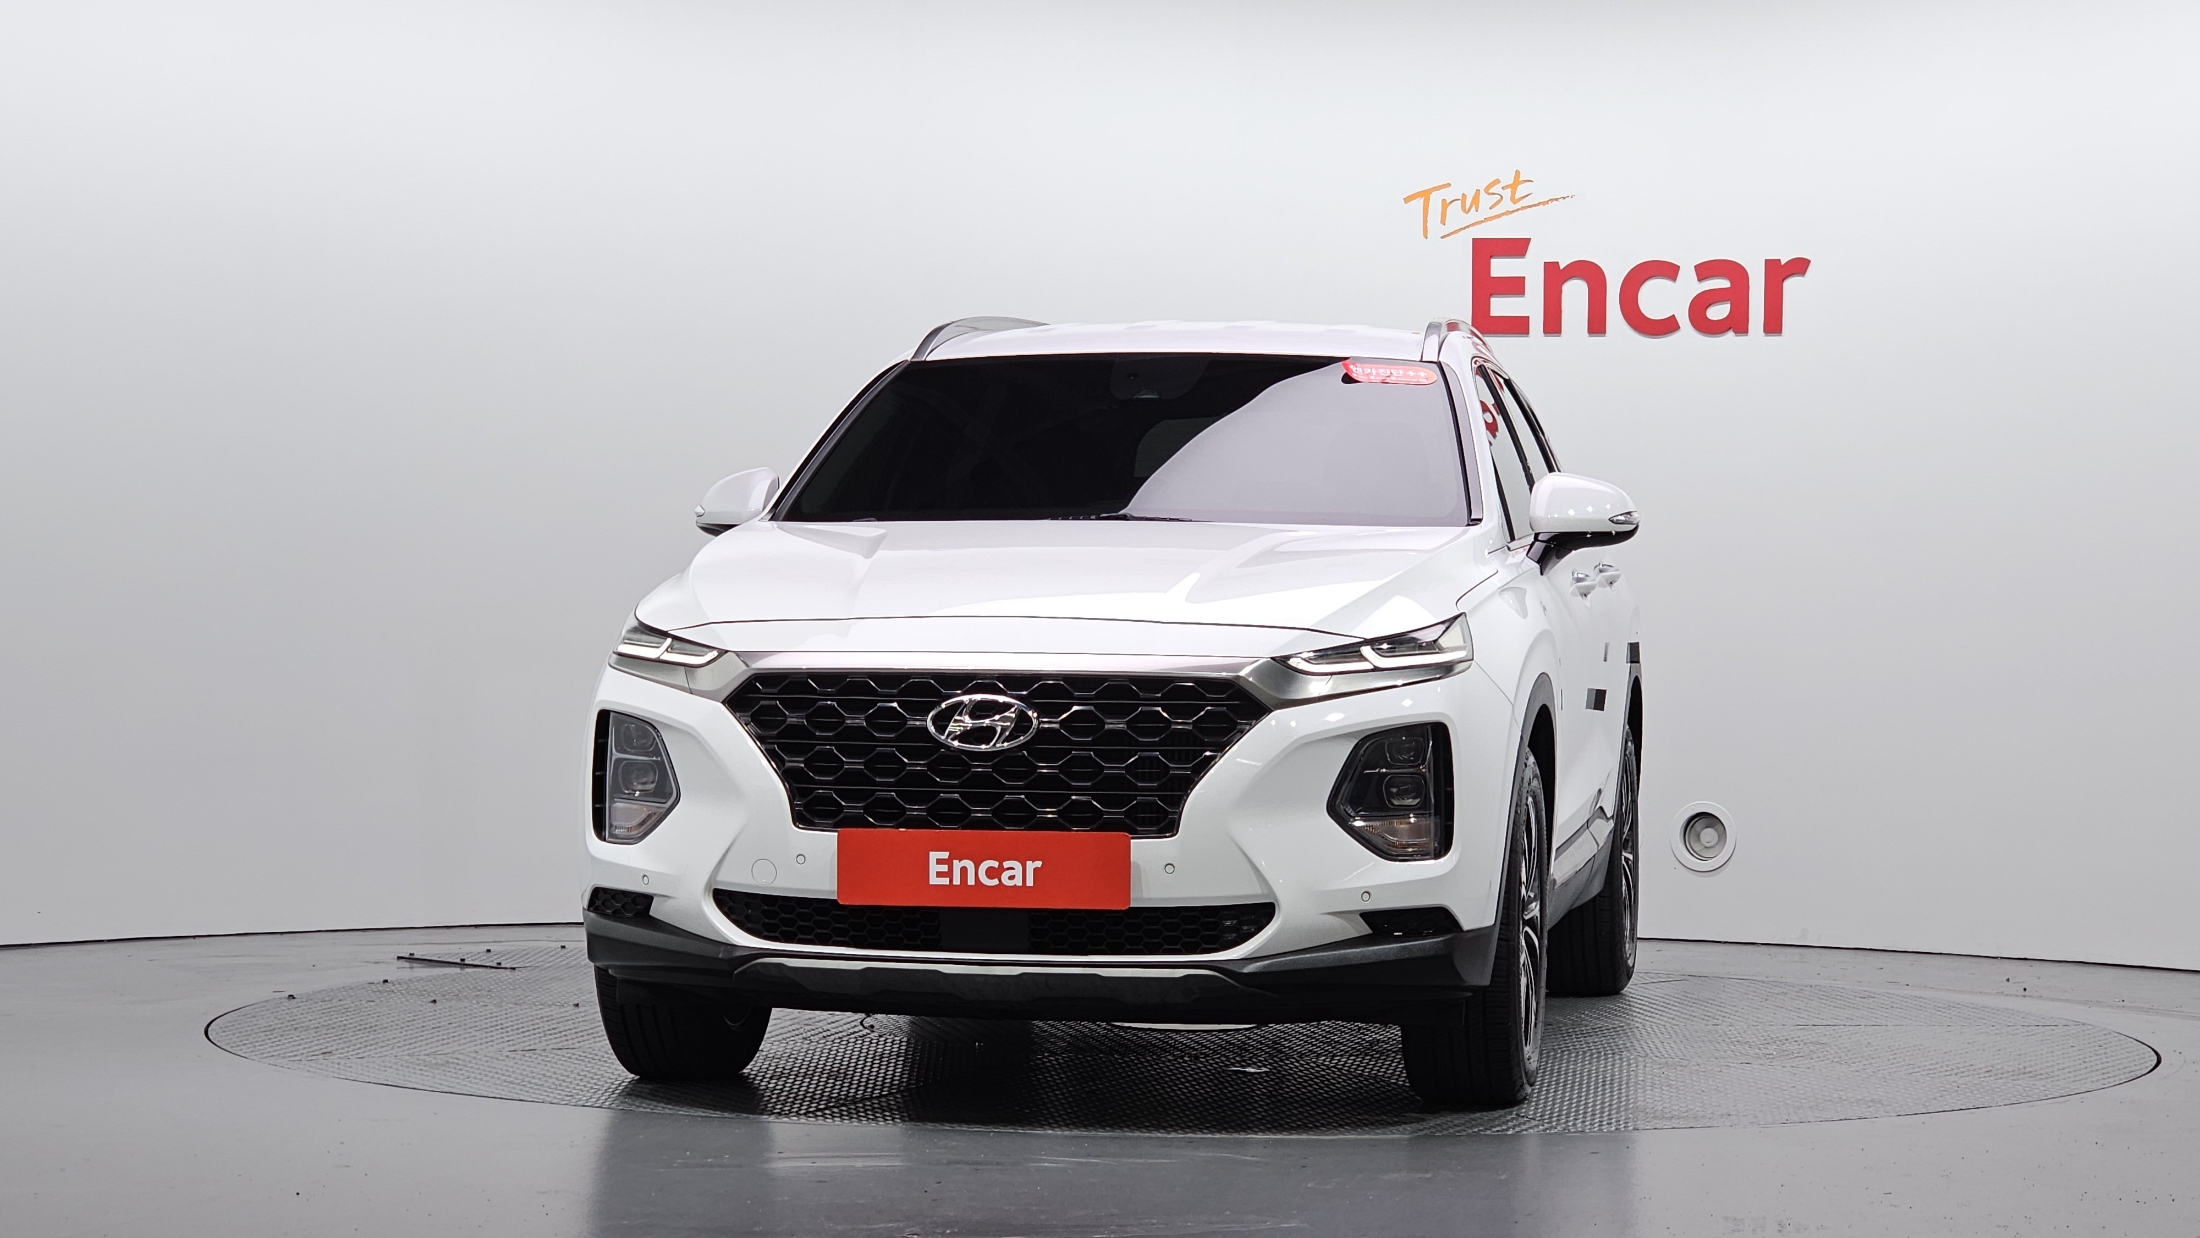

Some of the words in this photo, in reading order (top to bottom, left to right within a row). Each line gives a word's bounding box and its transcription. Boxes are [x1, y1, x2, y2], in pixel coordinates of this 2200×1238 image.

[1403, 170, 1534, 239] Trust
[1471, 237, 1811, 336] Encar
[928, 851, 1042, 887] Encar
